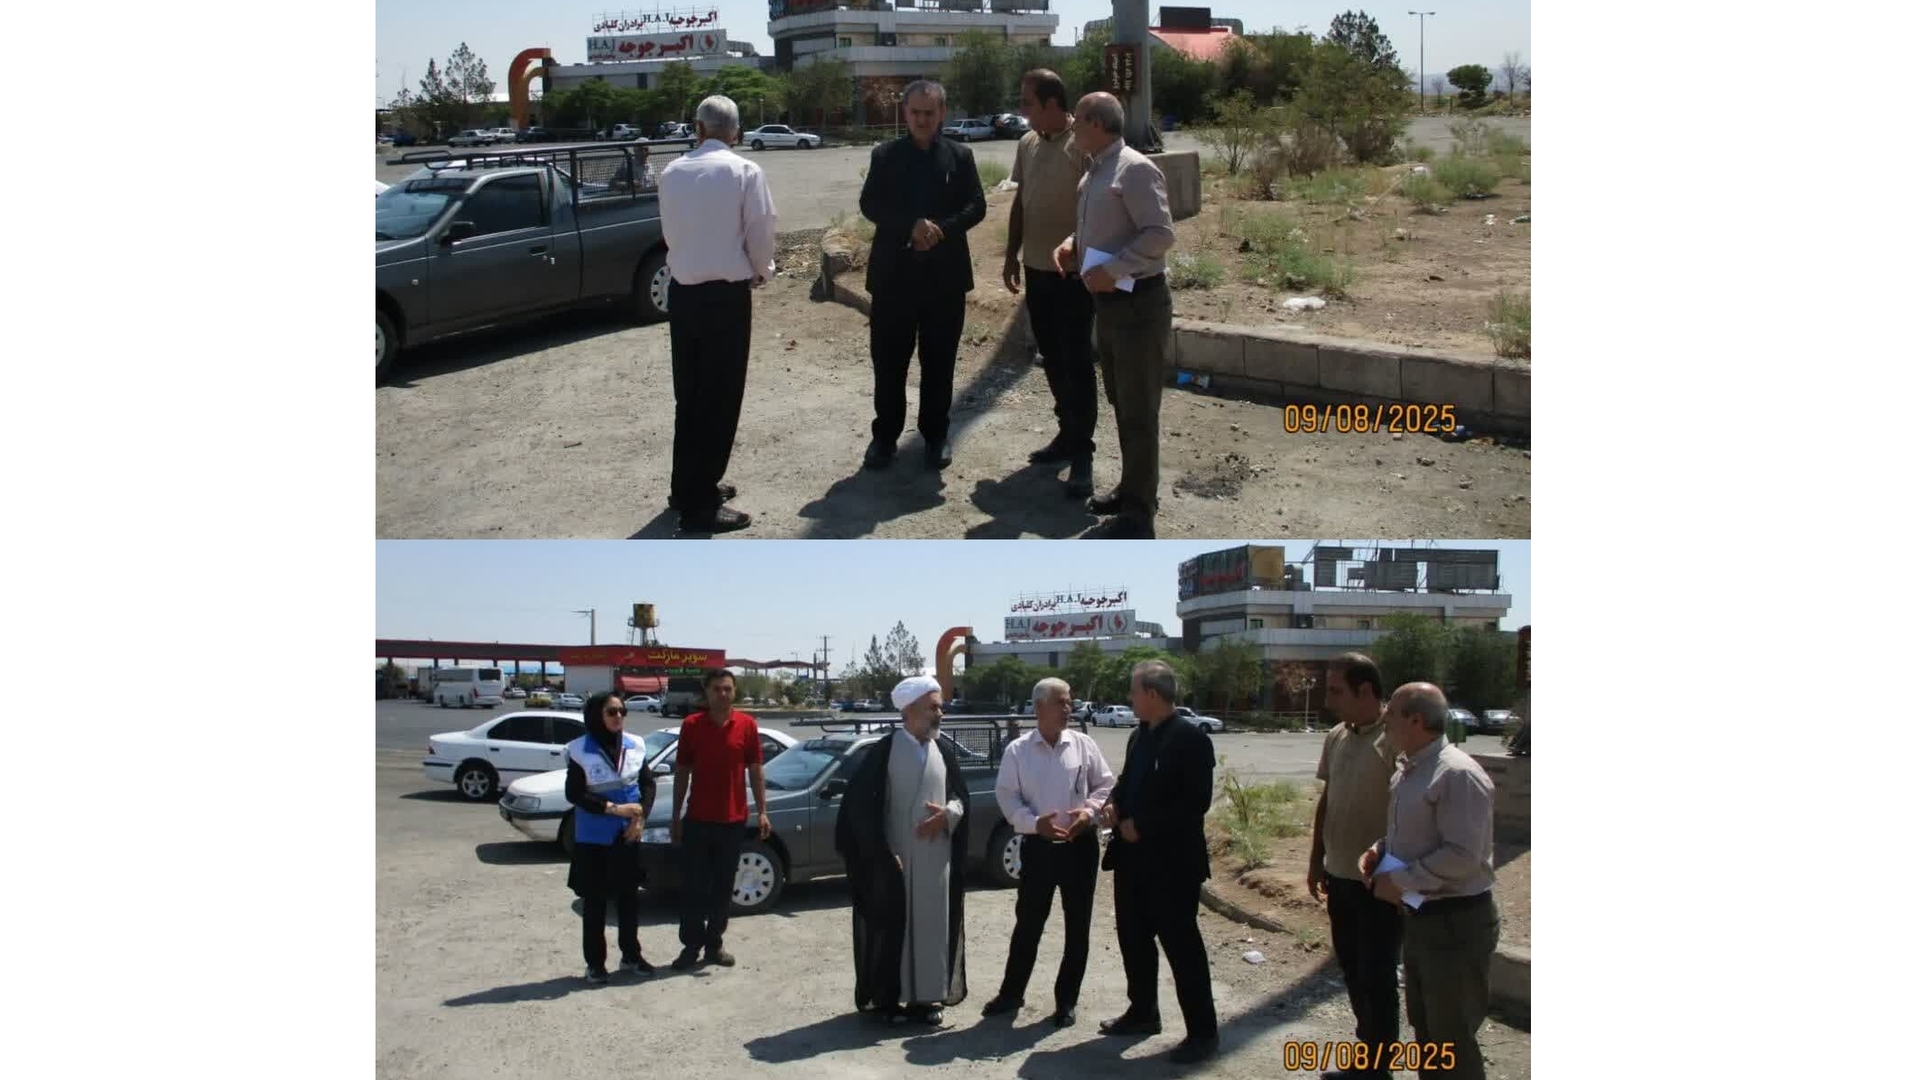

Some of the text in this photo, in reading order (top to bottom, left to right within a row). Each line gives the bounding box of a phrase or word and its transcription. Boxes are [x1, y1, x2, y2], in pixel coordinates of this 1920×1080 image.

[618, 40, 655, 59] جوجه
[656, 33, 695, 58] اکبر
[1032, 620, 1067, 638] جوجه
[1067, 614, 1103, 638] اکبر
[648, 650, 680, 666] مارکت
